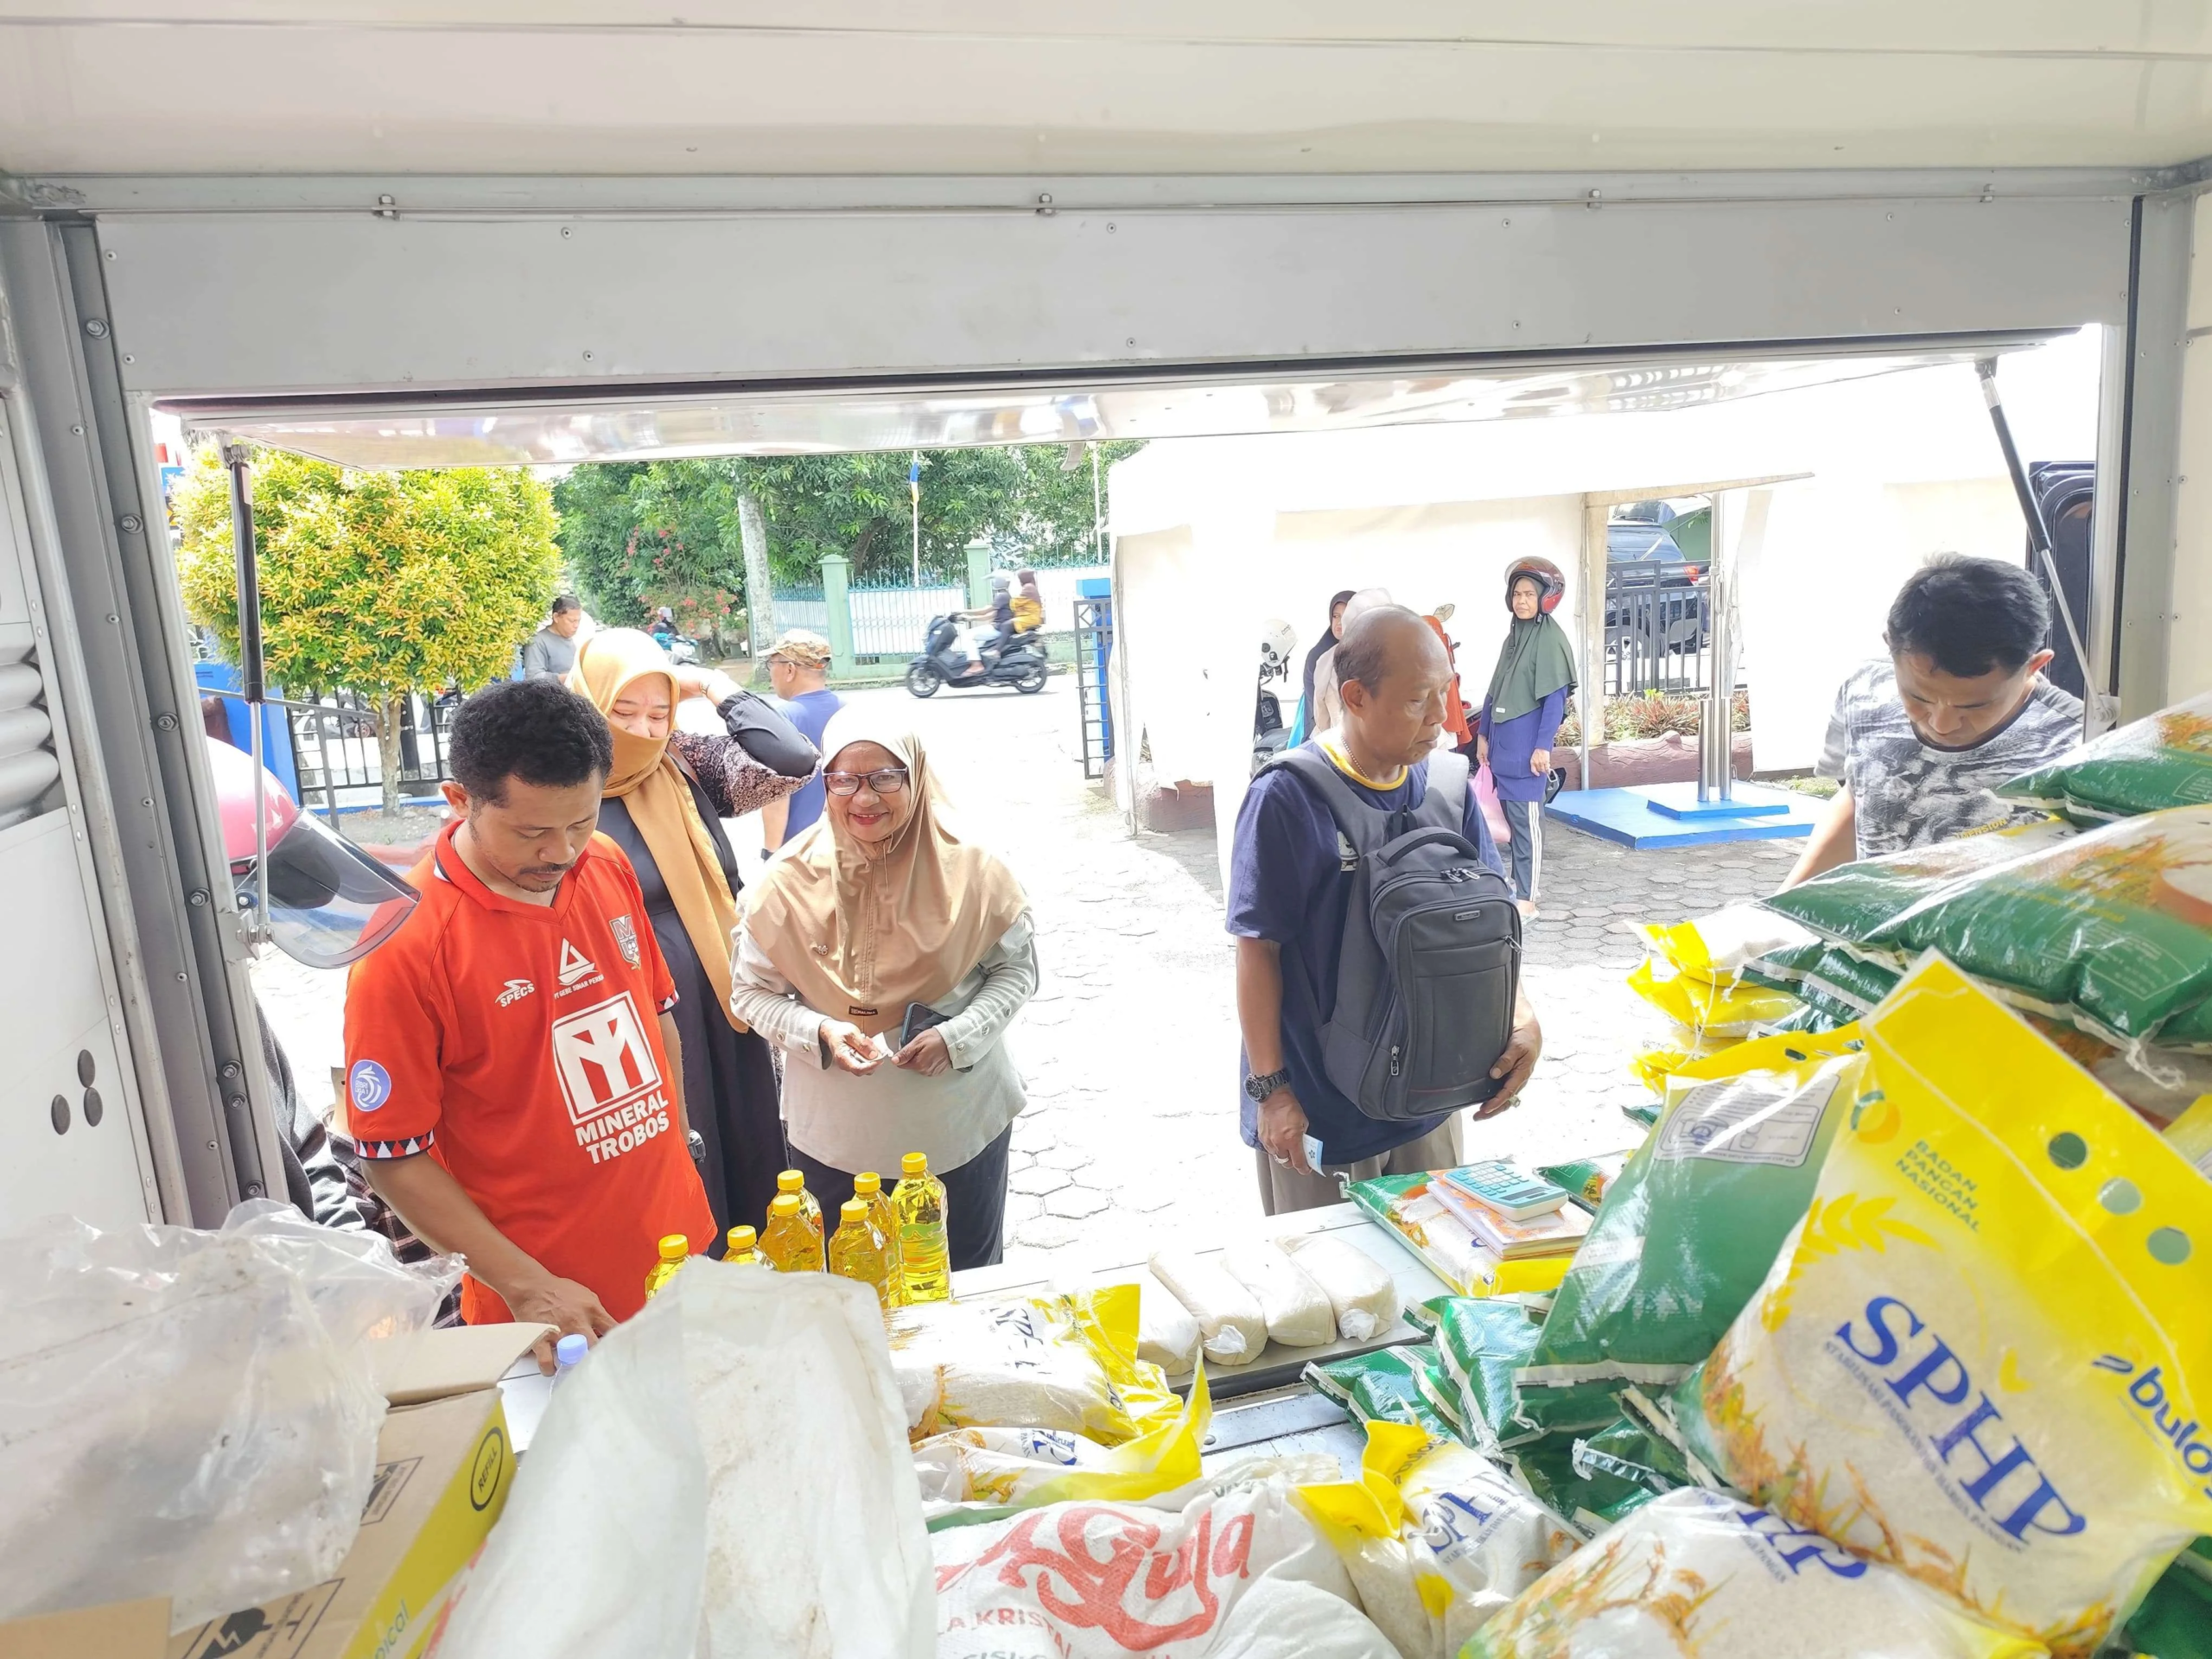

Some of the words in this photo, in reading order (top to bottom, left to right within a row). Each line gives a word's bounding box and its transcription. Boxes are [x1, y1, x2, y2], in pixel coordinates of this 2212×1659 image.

[1955, 818, 2007, 840] IMENSION
[500, 982, 535, 1007] SPECS
[575, 1090, 669, 1147] MINERAL
[586, 1110, 670, 1165] TROBOS
[1916, 1140, 1978, 1192] BADAN
[1895, 1159, 1980, 1233] NASIONAL
[1835, 1296, 2087, 1544] SPHP
[2128, 1365, 2212, 1502] bulo
[478, 1446, 499, 1492] REFILL
[998, 1507, 1255, 1651] Gula
